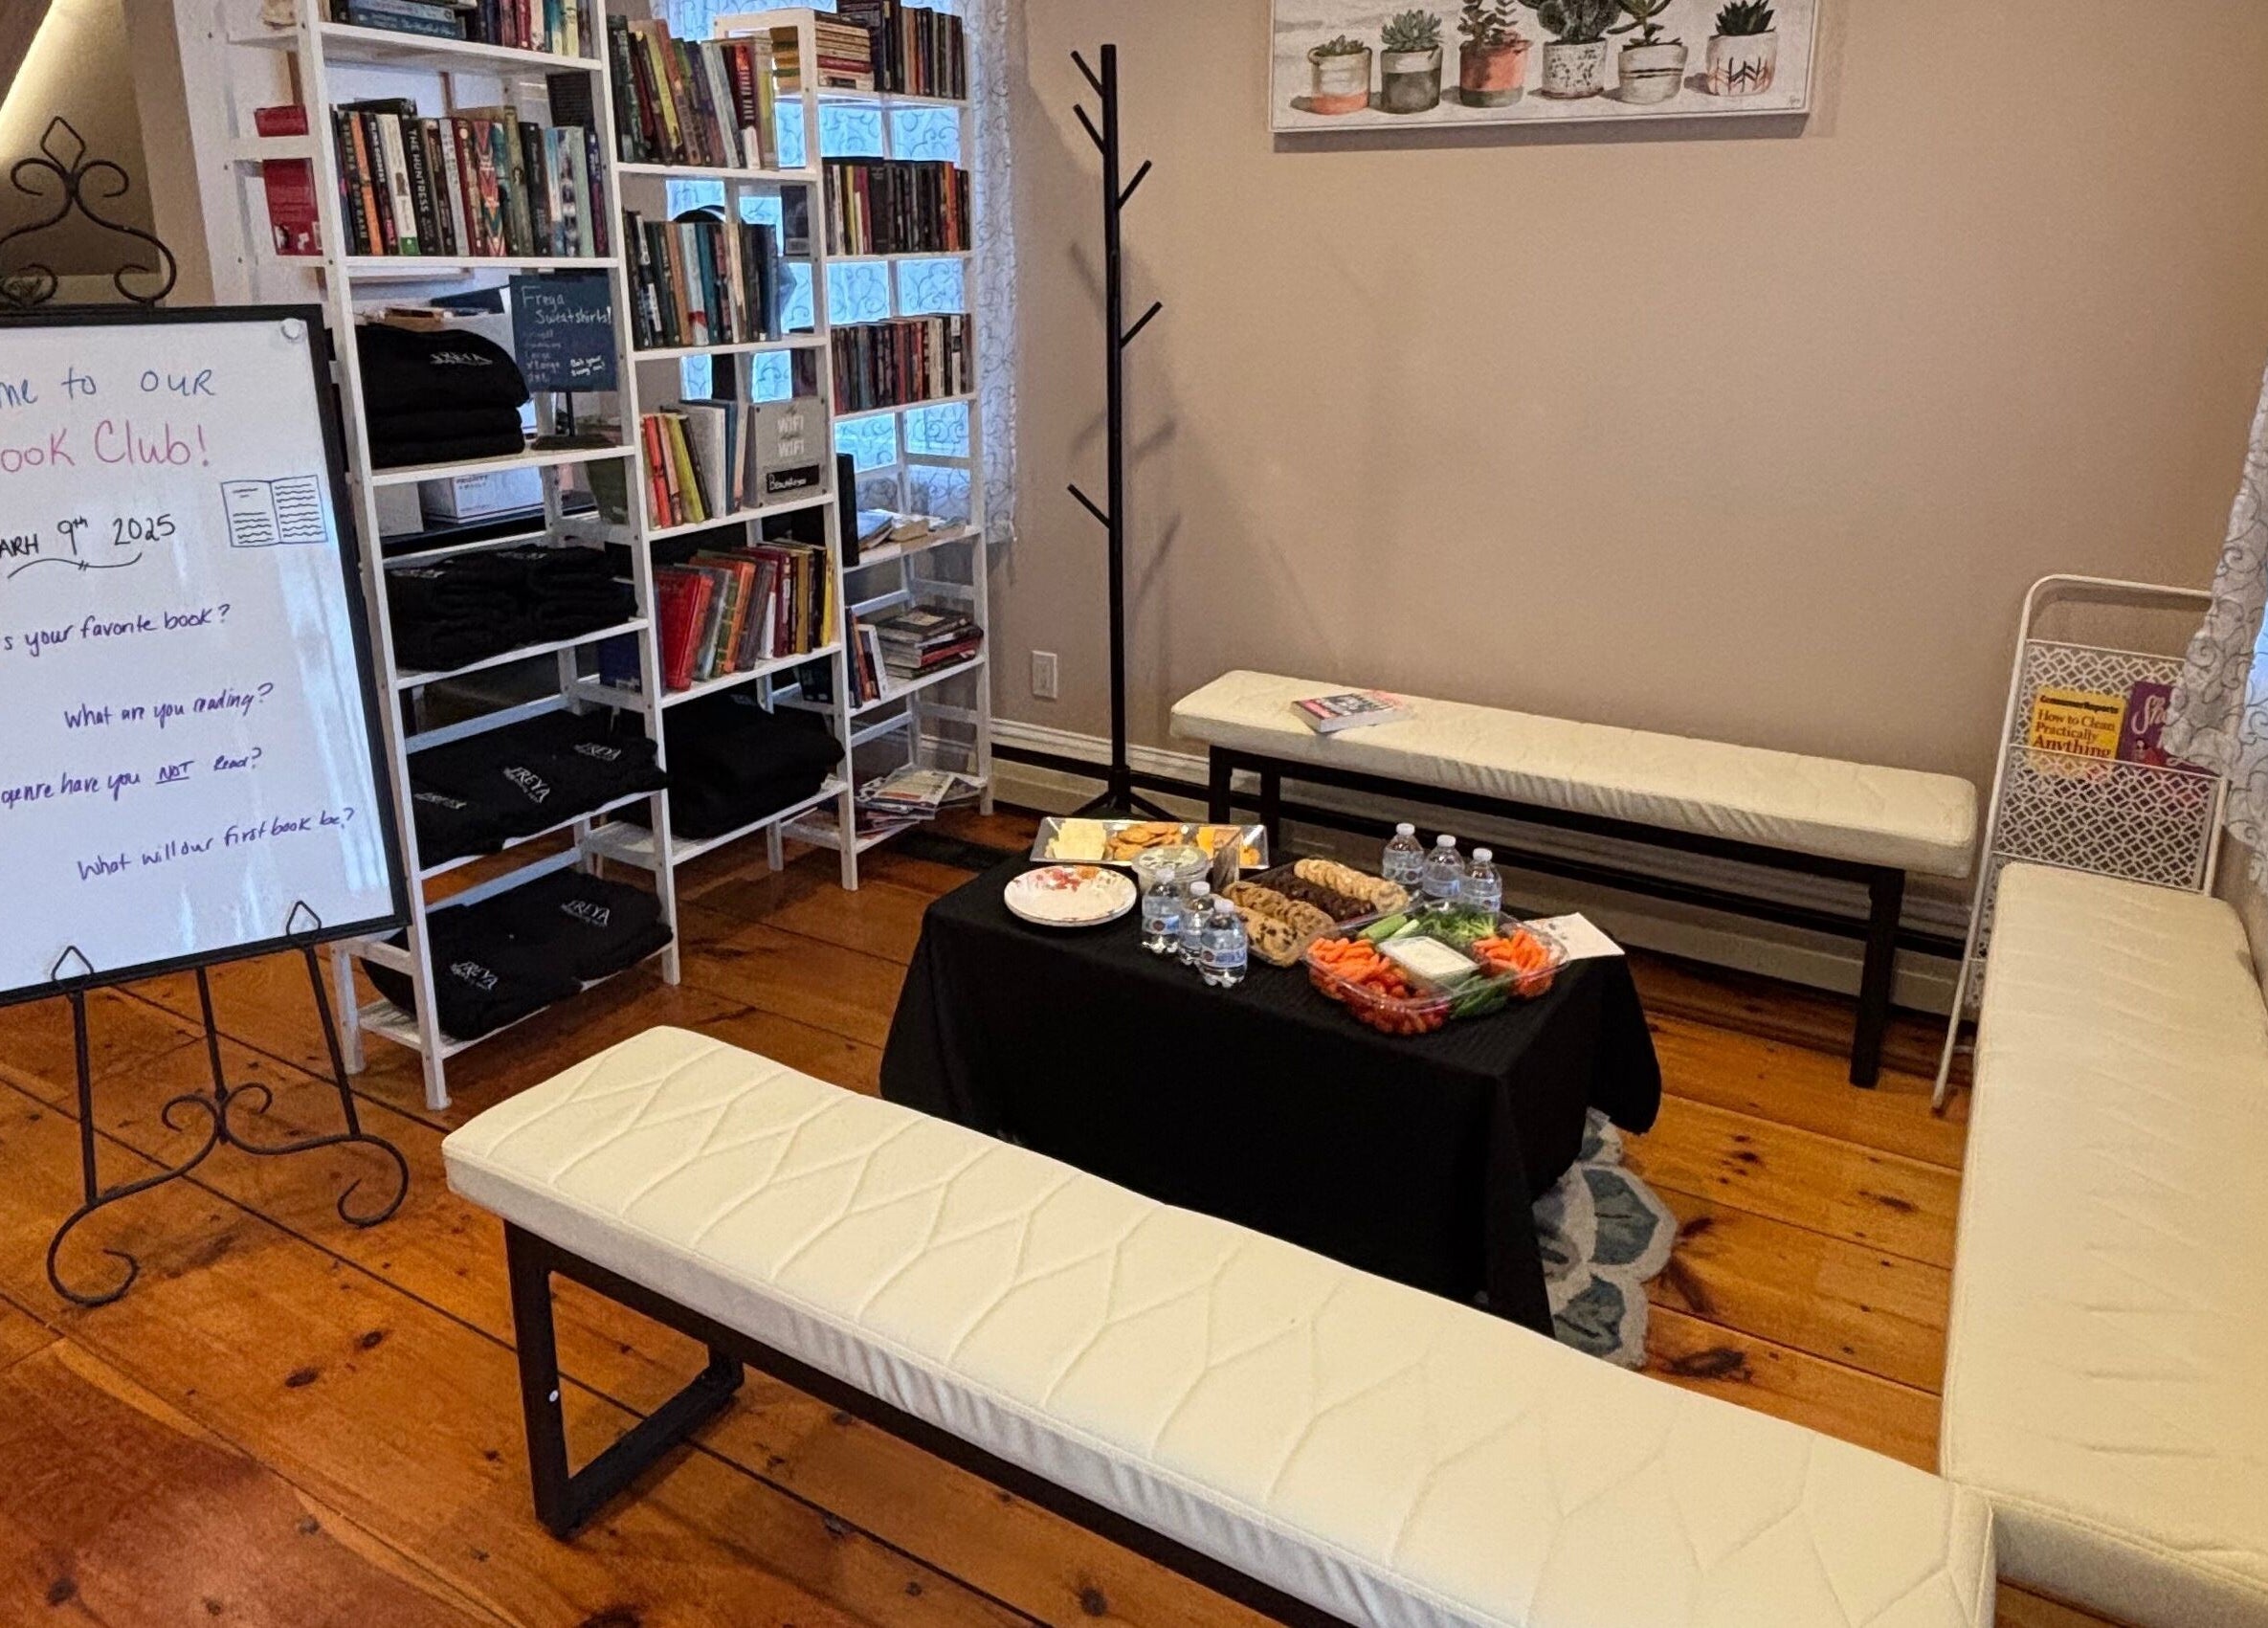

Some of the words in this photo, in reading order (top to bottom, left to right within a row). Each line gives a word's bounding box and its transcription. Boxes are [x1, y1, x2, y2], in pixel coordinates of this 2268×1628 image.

[408, 128, 420, 153] THE
[412, 153, 430, 212] HUNTRESS
[522, 285, 565, 313] Freya
[61, 367, 97, 400] to
[96, 419, 210, 468] Club!
[56, 516, 88, 555] 9th
[113, 514, 176, 546] 2025
[24, 625, 74, 658] your
[80, 615, 158, 639] favorite
[164, 604, 231, 631] book?
[64, 704, 111, 729] What
[153, 703, 185, 729] you
[193, 682, 274, 716] reading?
[2037, 709, 2065, 724] How
[2067, 715, 2079, 725] to
[2080, 716, 2116, 731] Clean
[2032, 733, 2112, 759] Anything
[2035, 722, 2099, 744] Practically
[1, 783, 55, 810] genre
[60, 771, 101, 795] have
[107, 771, 141, 801] you
[156, 760, 195, 783] NOT
[78, 855, 131, 881] What
[142, 841, 176, 867] will
[180, 839, 215, 856] our
[224, 823, 267, 848] first
[270, 816, 312, 837] book
